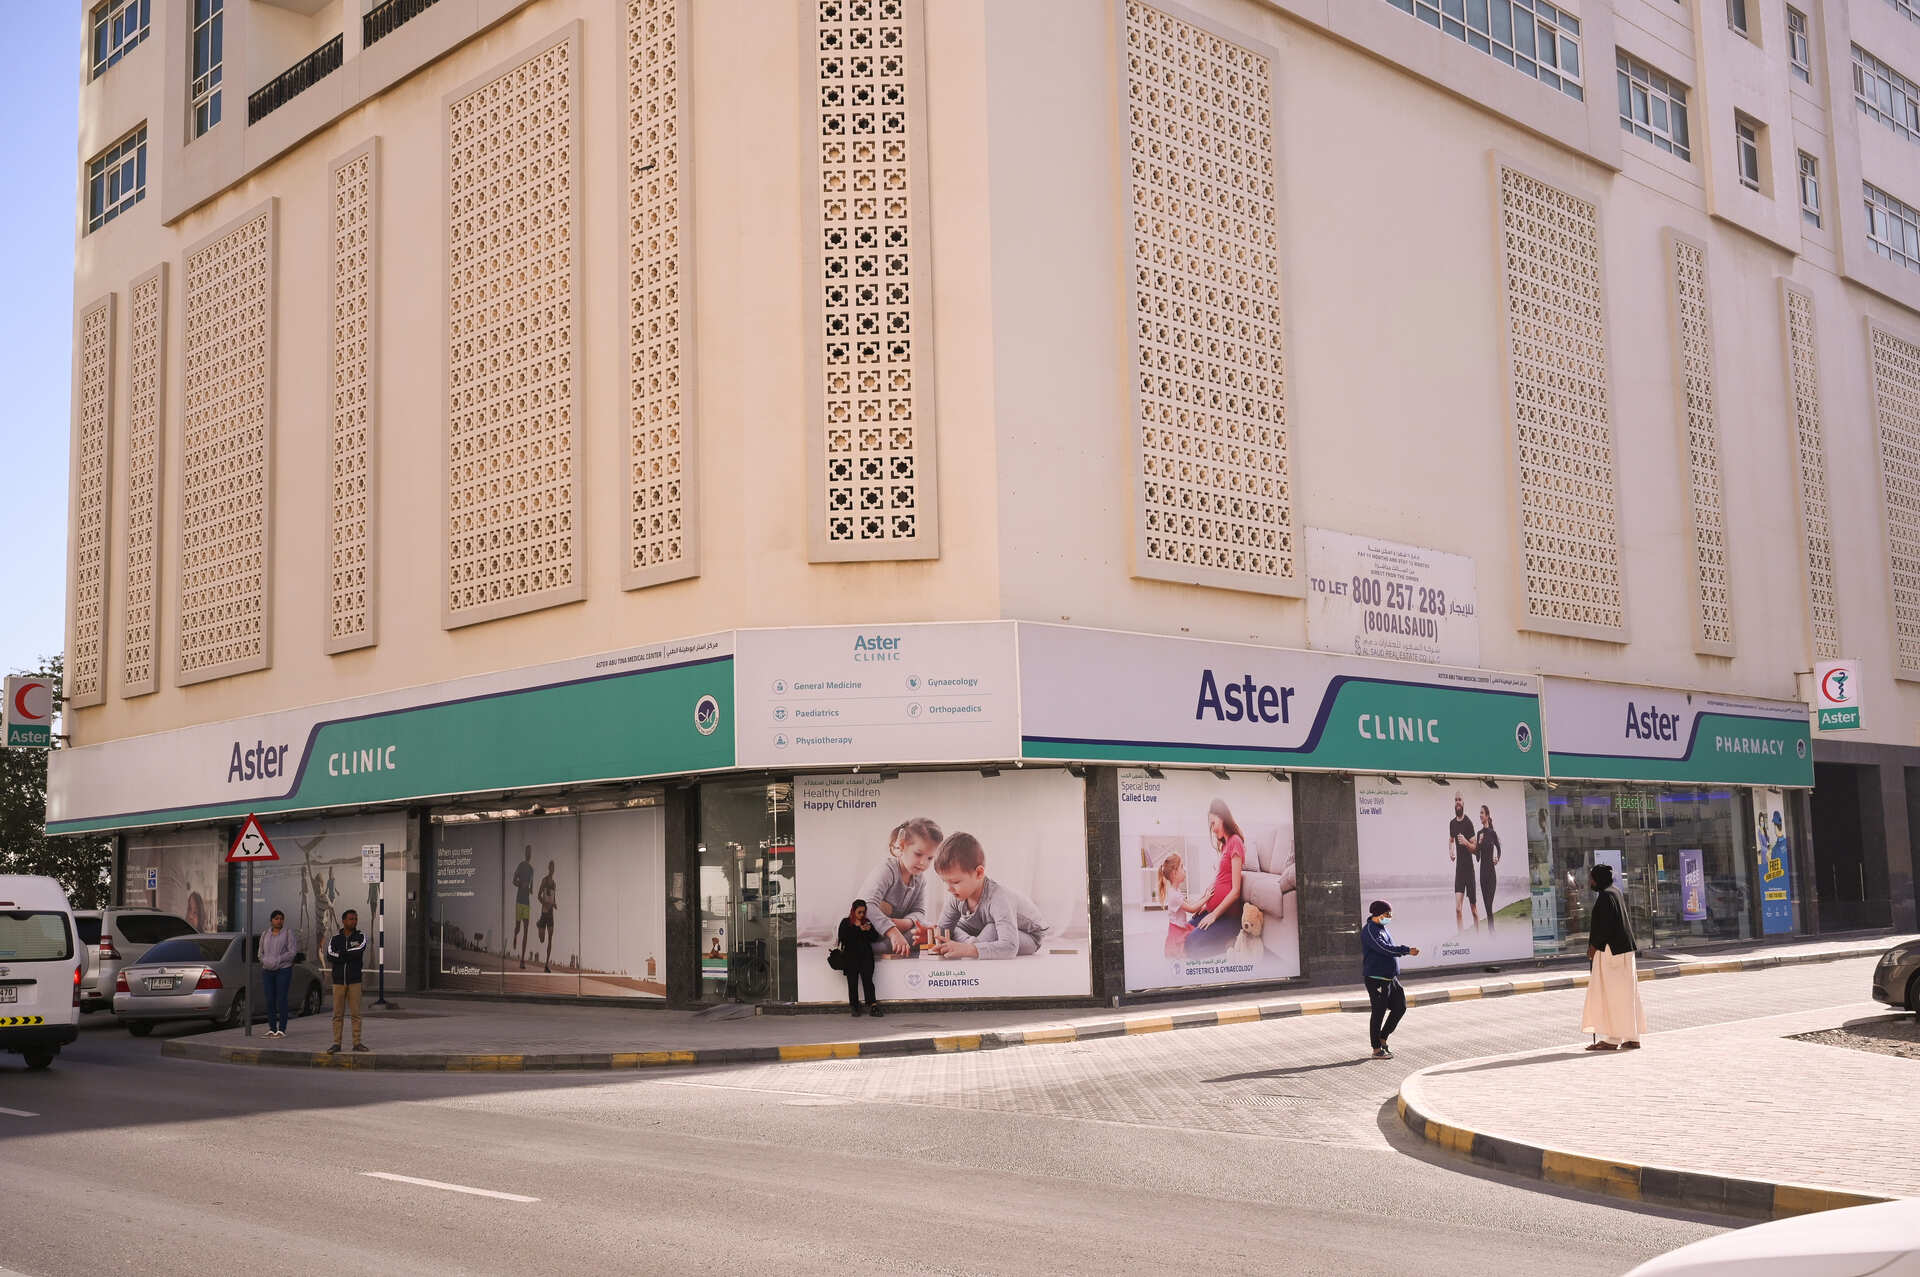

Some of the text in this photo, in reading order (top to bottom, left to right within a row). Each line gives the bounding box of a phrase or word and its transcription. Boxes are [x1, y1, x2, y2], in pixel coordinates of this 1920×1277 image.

[1311, 576, 1445, 616] TO LET 800 257 283
[1364, 610, 1438, 642] (800ALSAUD)
[854, 634, 901, 650] Aster
[854, 652, 901, 662] CLINIC
[794, 681, 862, 690] General Medicine
[928, 677, 978, 687] Gynaecology
[1196, 669, 1295, 724] Aster
[795, 709, 839, 718] Paediatrics
[929, 704, 982, 714] Orthopaedics
[1625, 702, 1680, 742] Aster
[1821, 710, 1857, 724] Aster
[1358, 714, 1440, 743] CLINIC
[10, 730, 48, 744] Aster
[796, 736, 853, 746] Physiotherapy
[1715, 735, 1784, 756] PHARMACY
[228, 740, 288, 783] Aster
[328, 745, 396, 777] CLINIC
[1121, 782, 1160, 792] Special Bond
[803, 787, 881, 799] Healthy Children
[1121, 793, 1157, 802] Called Love
[803, 800, 877, 811] Happy Children
[451, 966, 480, 976] #LiveBetter
[1186, 966, 1214, 976] OBSTETRICS
[1220, 965, 1253, 974] GYNAECOLOGY
[928, 978, 979, 987] PAEDIATRICS
